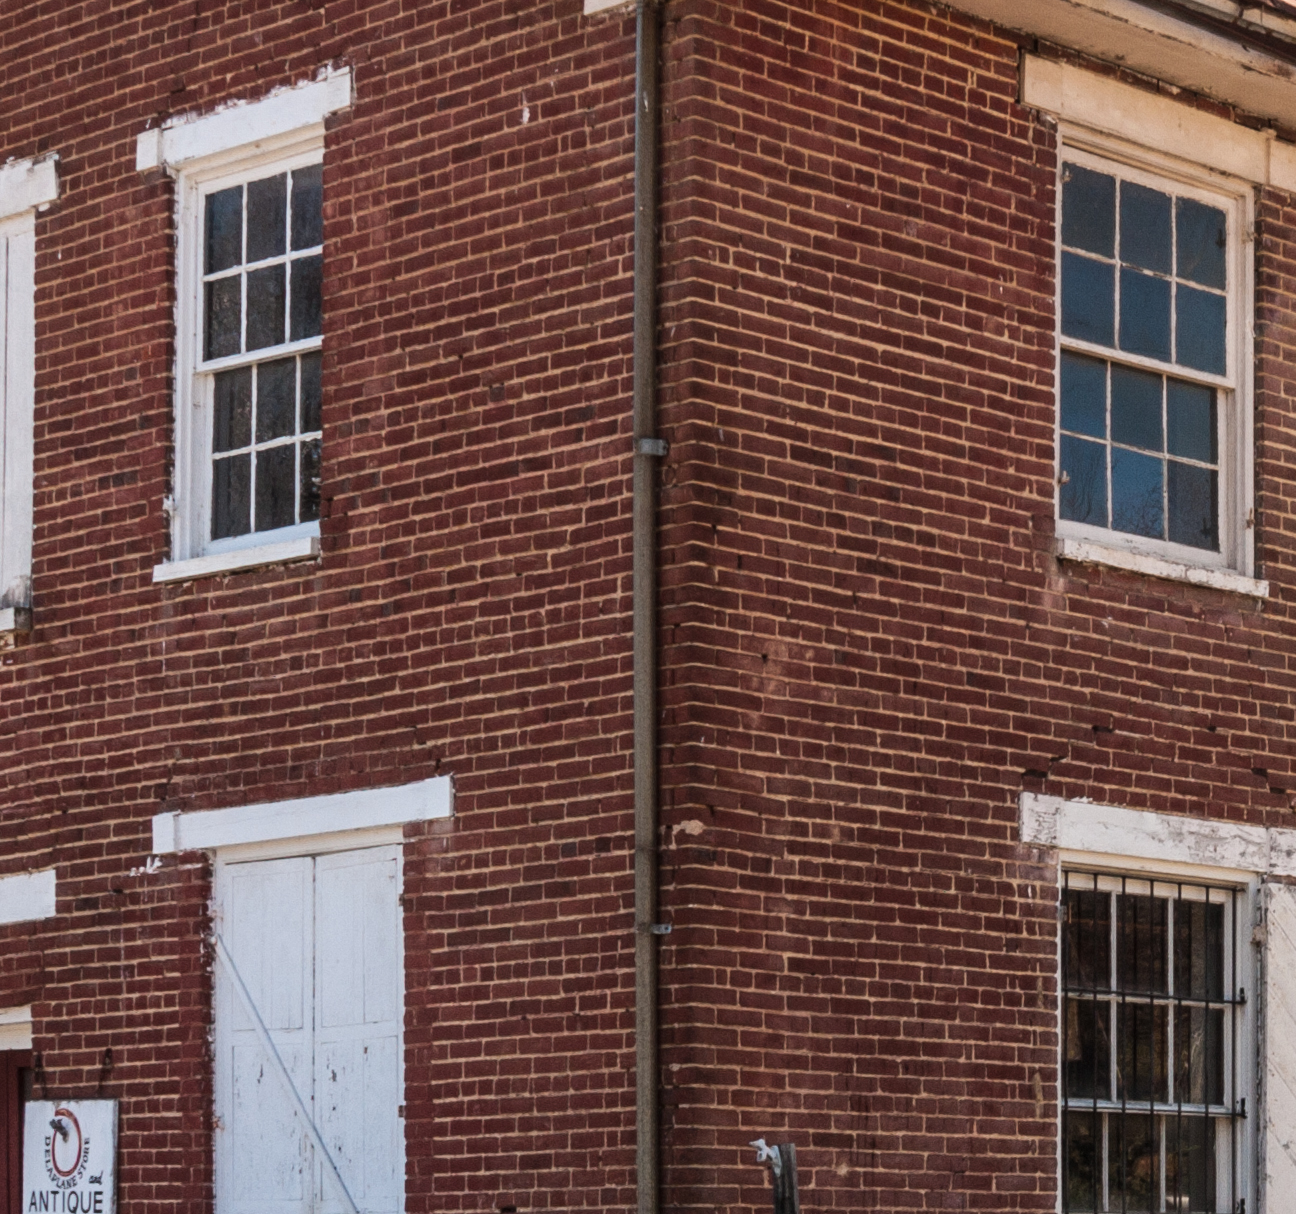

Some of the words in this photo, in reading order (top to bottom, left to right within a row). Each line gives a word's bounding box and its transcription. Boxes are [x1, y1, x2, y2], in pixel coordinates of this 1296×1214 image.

[45, 1135, 78, 1189] DELAPLANE
[77, 1137, 90, 1180] STORE
[28, 1190, 104, 1214] ANTIQUE
